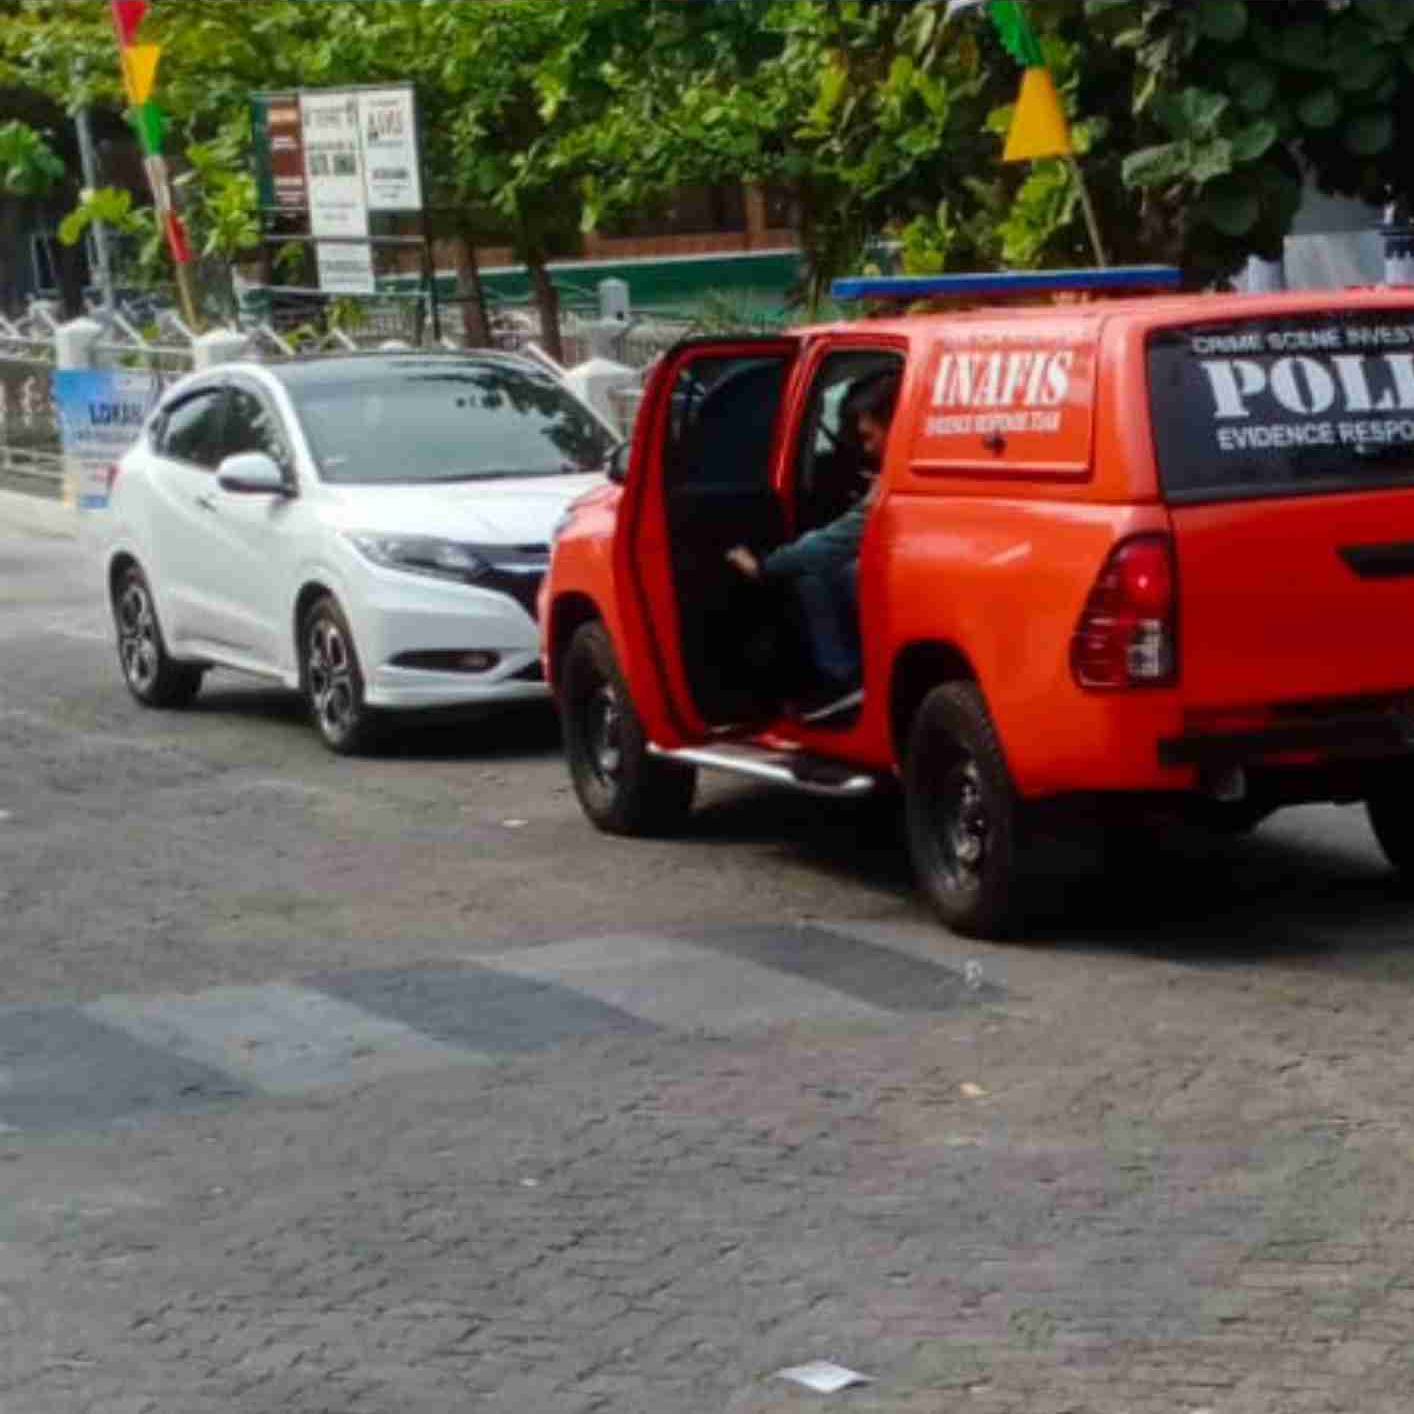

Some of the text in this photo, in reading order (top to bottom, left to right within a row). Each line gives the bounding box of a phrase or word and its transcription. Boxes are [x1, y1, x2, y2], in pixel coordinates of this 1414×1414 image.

[1191, 334, 1260, 354] CRIME
[1267, 330, 1340, 350] SCENE
[931, 352, 1071, 407] INAFIS
[1217, 423, 1334, 450] EVIDENCE
